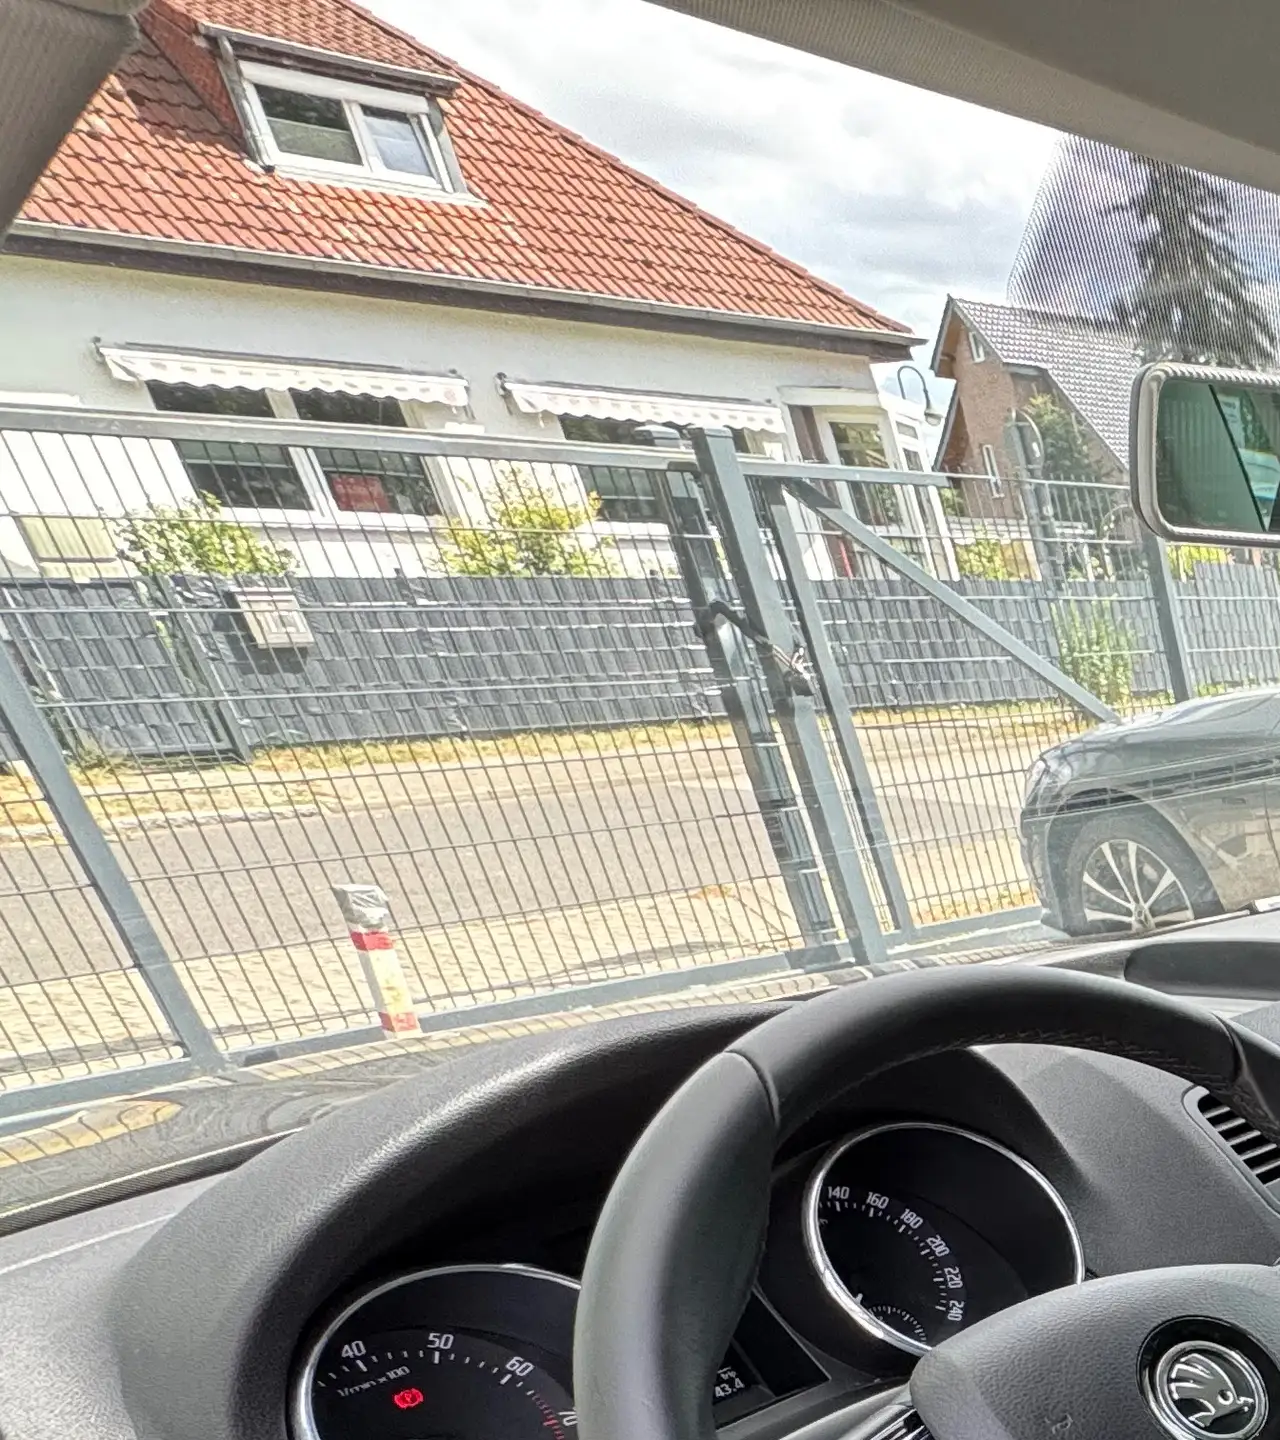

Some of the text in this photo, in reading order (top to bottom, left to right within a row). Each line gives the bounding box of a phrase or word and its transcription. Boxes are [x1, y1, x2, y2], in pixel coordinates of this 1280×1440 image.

[827, 1186, 850, 1200] 140
[866, 1191, 890, 1210] 160
[900, 1208, 924, 1229] 180
[926, 1234, 950, 1258] 200
[943, 1266, 963, 1289] 220
[947, 1300, 965, 1322] 240
[340, 1340, 366, 1360] 40
[426, 1332, 454, 1350] 50
[505, 1356, 535, 1377] 60
